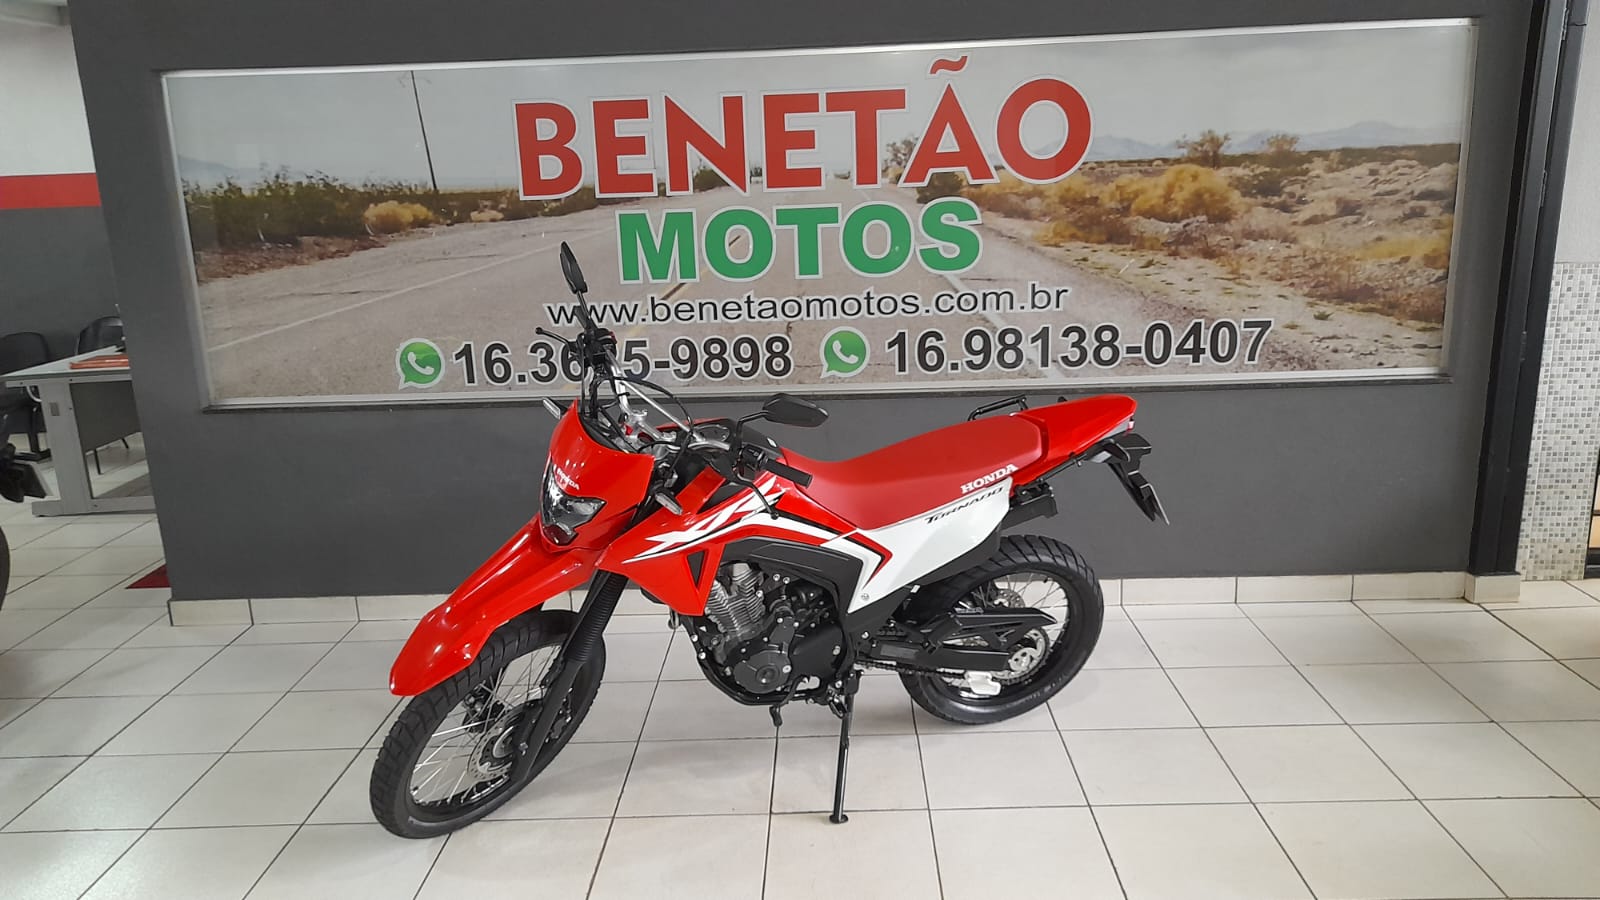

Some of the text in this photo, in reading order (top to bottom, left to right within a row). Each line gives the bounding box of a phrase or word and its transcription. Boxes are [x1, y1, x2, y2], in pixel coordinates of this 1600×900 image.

[514, 55, 1092, 200] BENETÃO
[617, 200, 981, 283] MOTOS
[546, 285, 1069, 325] www.benetaomotos.com.br
[454, 336, 791, 385] 16.365-9898
[887, 320, 1273, 373] 16.98138-0407
[960, 463, 1019, 494] HONDA
[924, 486, 1004, 524] TORNADO
